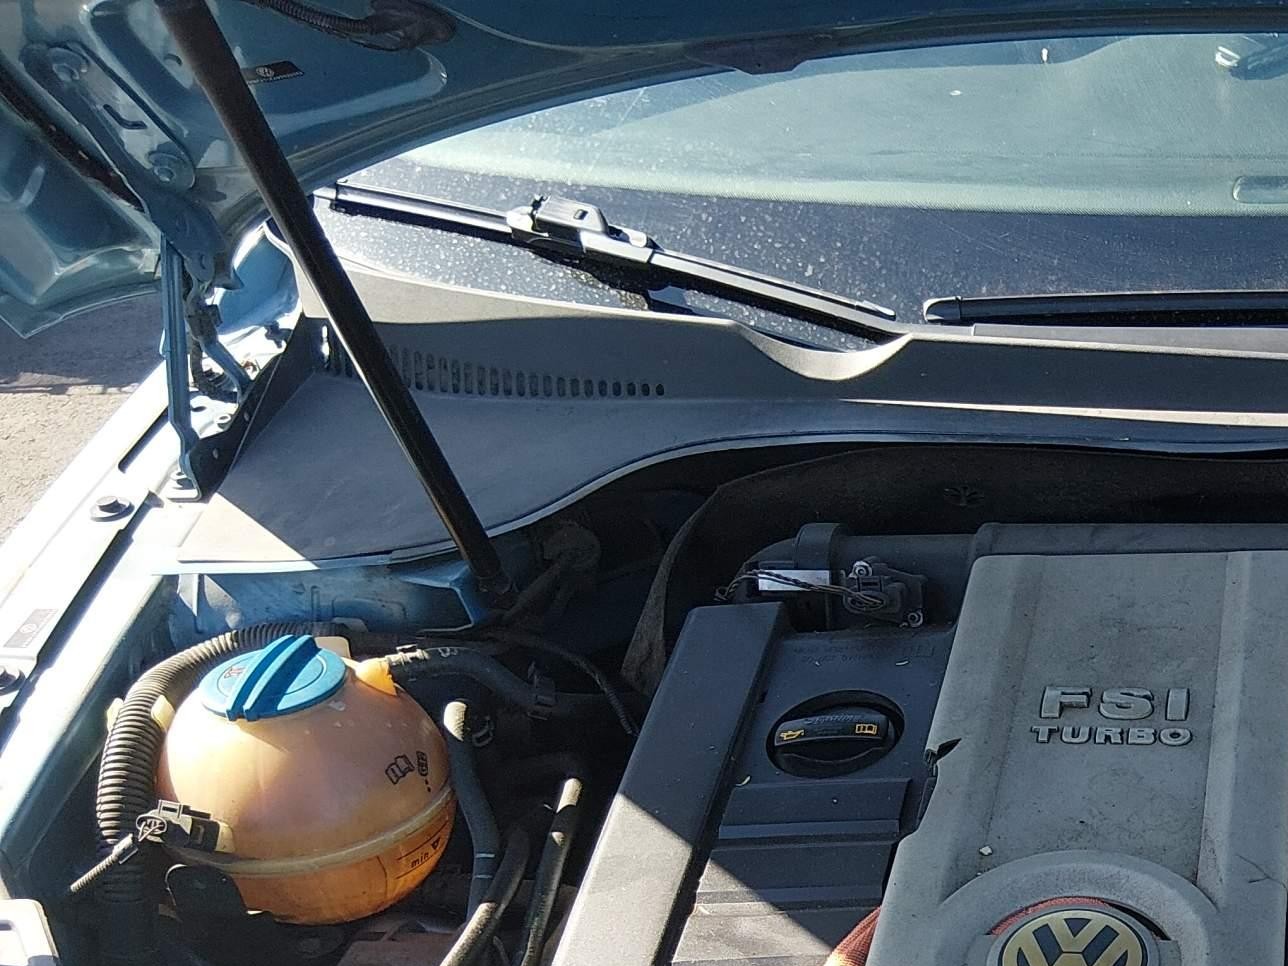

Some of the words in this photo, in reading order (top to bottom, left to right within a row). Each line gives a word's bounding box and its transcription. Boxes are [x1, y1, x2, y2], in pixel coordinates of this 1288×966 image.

[1040, 685, 1190, 721] FSI
[1031, 725, 1193, 746] TURBO
[411, 852, 430, 868] min
